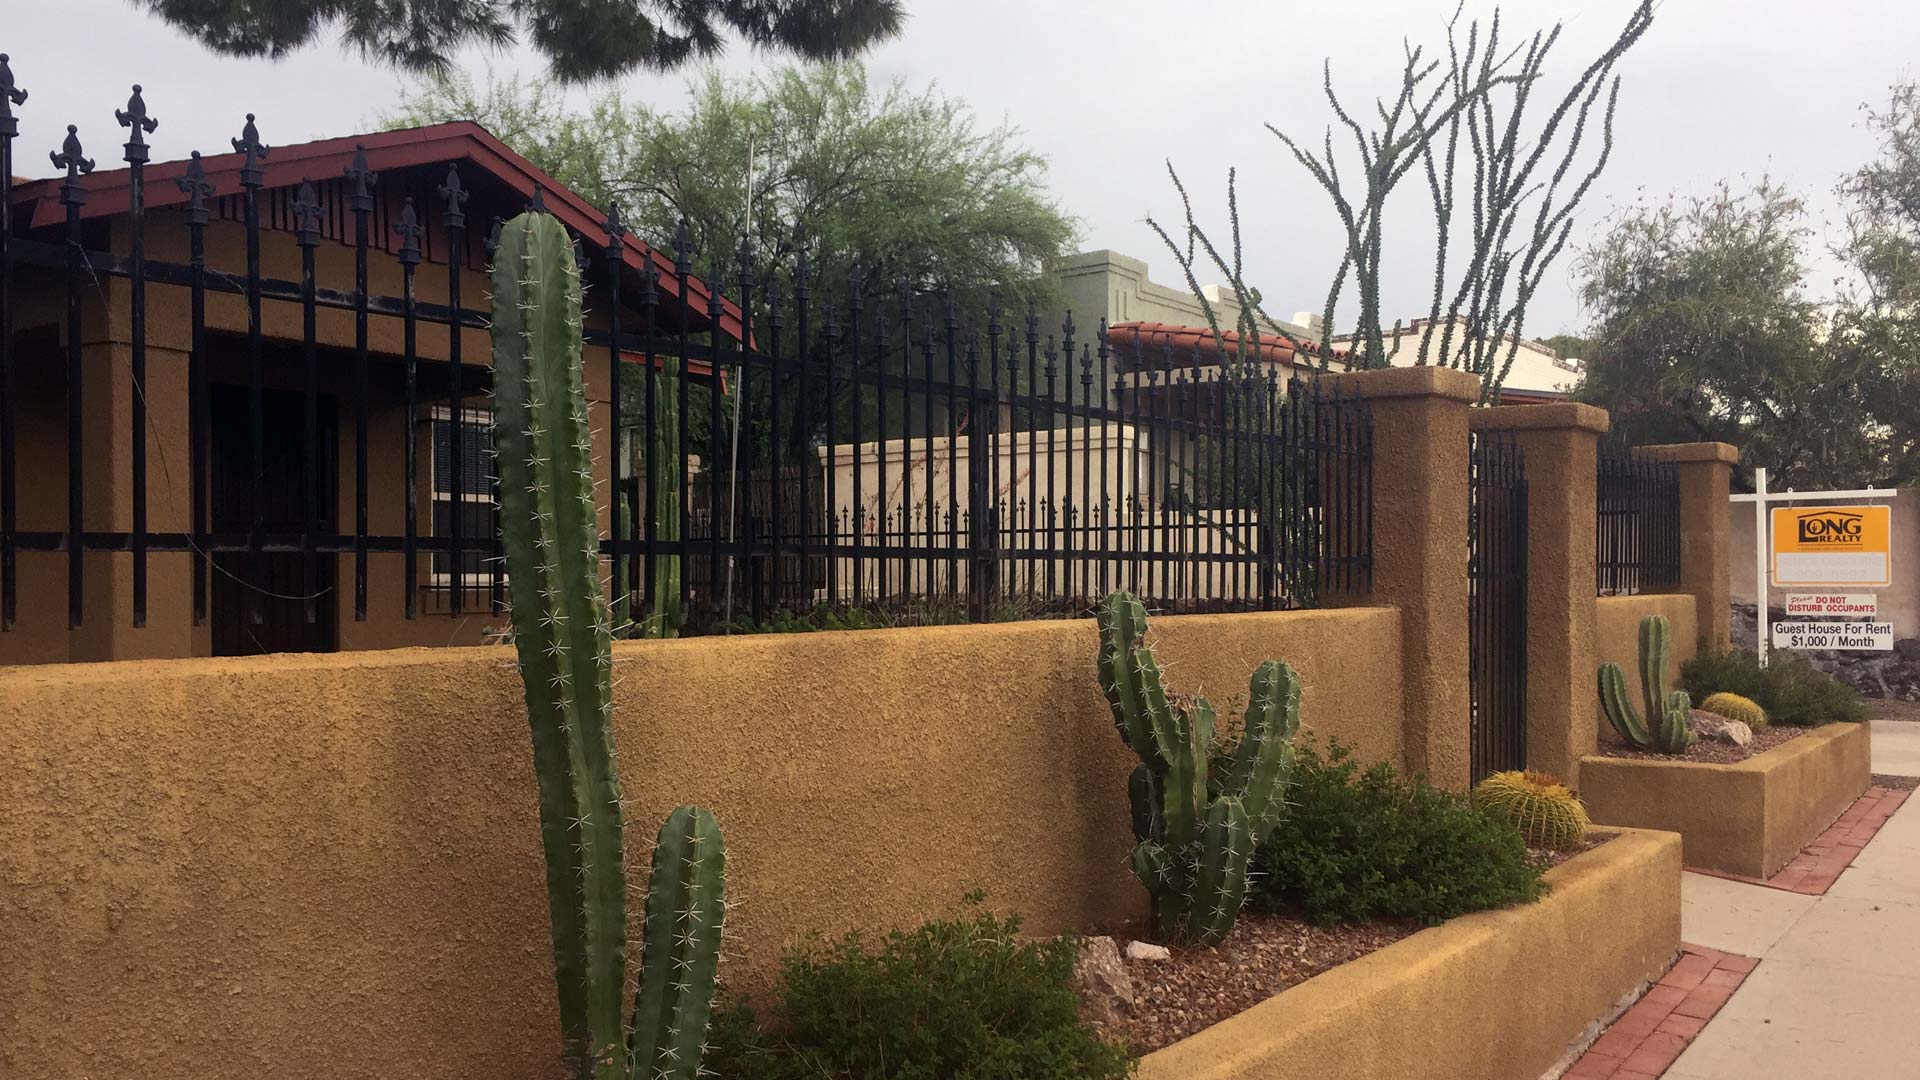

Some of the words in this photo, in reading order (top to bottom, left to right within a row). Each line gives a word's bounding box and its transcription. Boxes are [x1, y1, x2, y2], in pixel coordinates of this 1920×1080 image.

[1798, 519, 1862, 542] LONG
[1816, 596, 1828, 604] DO
[1829, 596, 1847, 604] NOT
[1788, 604, 1823, 612] DISTURB
[1826, 604, 1875, 612] OCCUPANTS
[1775, 623, 1806, 634] Guest
[1808, 623, 1842, 634] House
[1845, 623, 1863, 634] For
[1866, 623, 1891, 634] Rent
[1791, 635, 1828, 648] $1,000
[1830, 636, 1835, 646] /
[1838, 636, 1875, 647] Month
